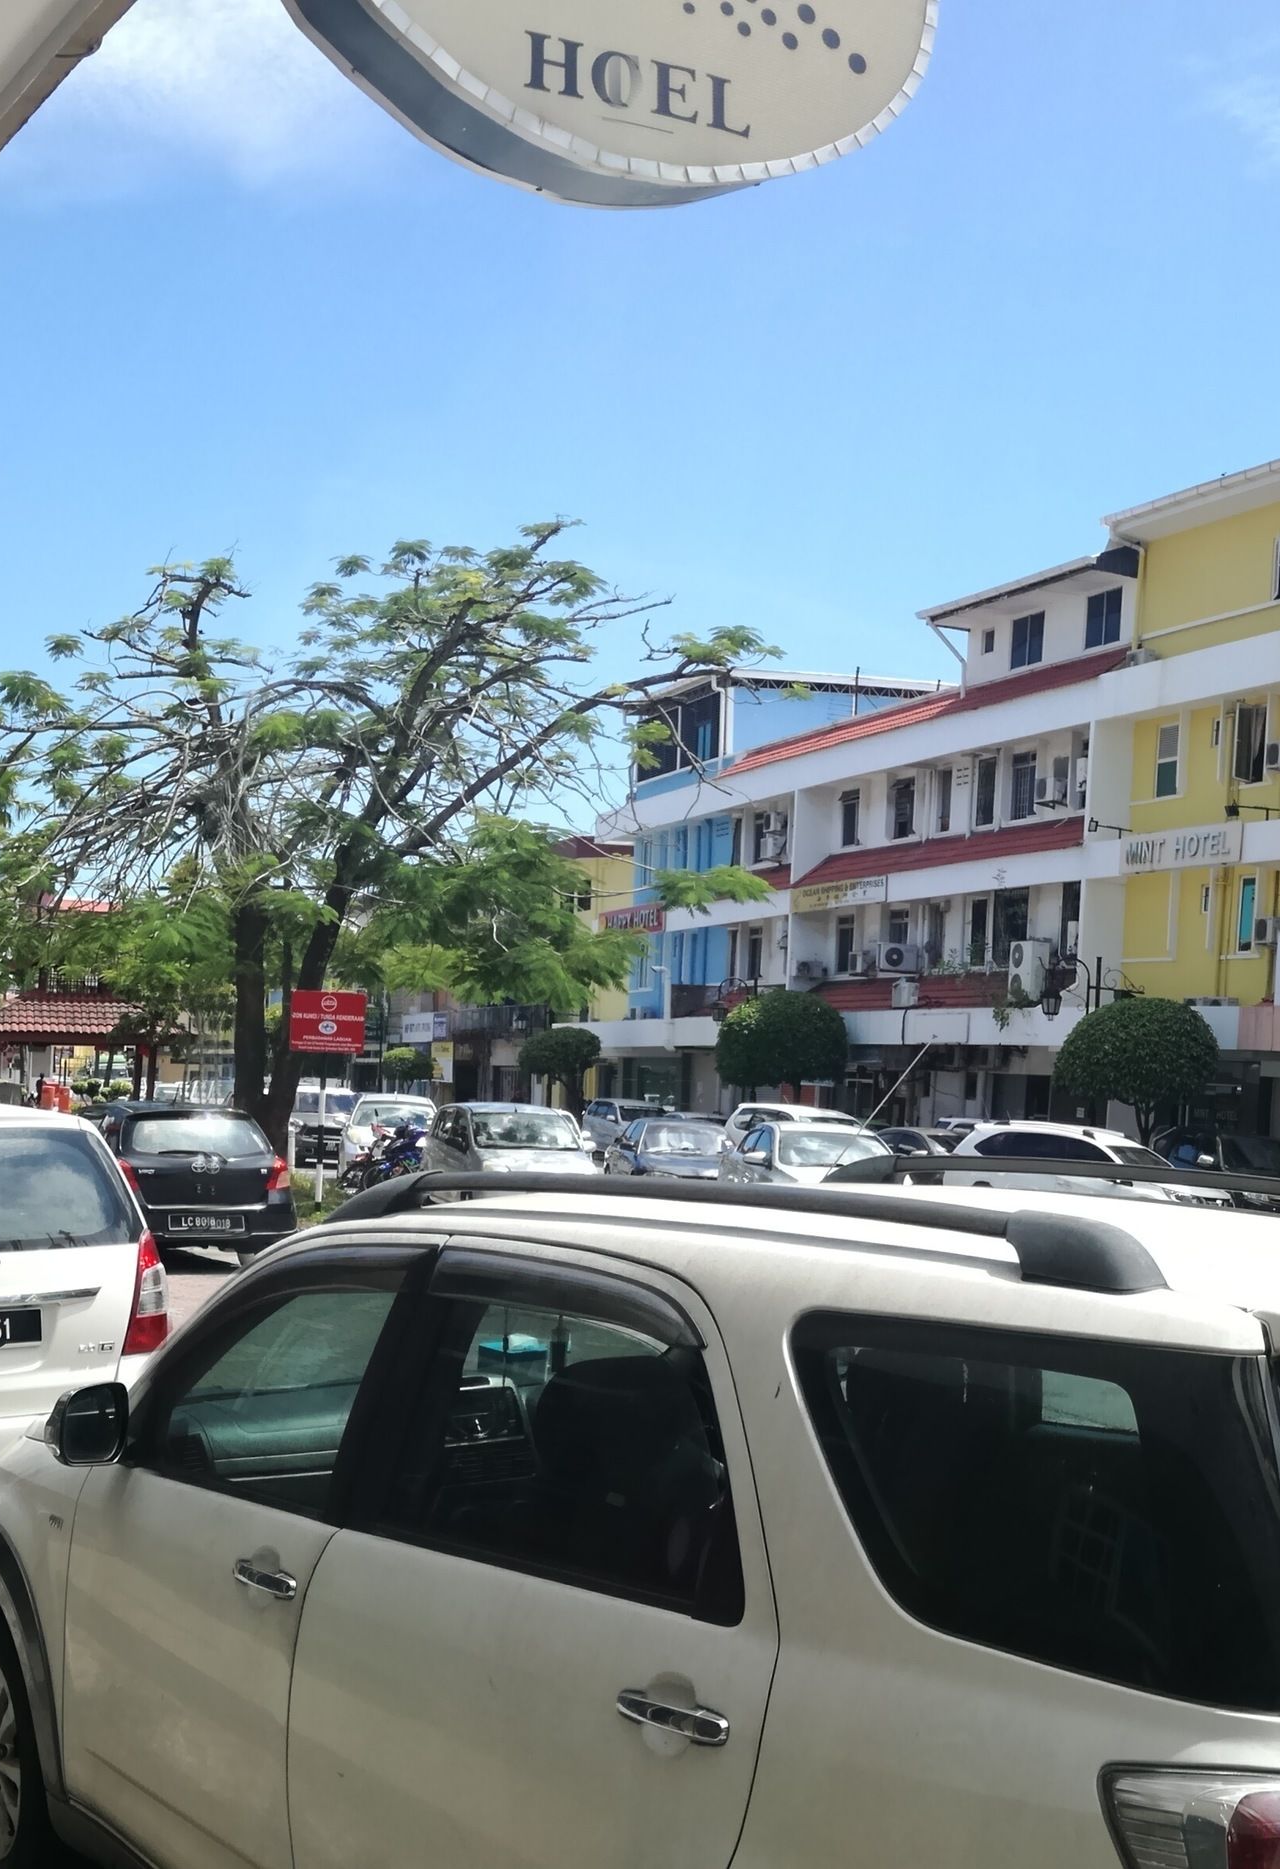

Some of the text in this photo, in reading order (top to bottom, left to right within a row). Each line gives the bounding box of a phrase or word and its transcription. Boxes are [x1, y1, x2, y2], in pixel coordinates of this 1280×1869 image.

[1125, 831, 1231, 865] MINT HOTEL
[849, 878, 885, 891] ENTERPRISES
[633, 908, 659, 929] HOTEL
[182, 1217, 194, 1227] LC
